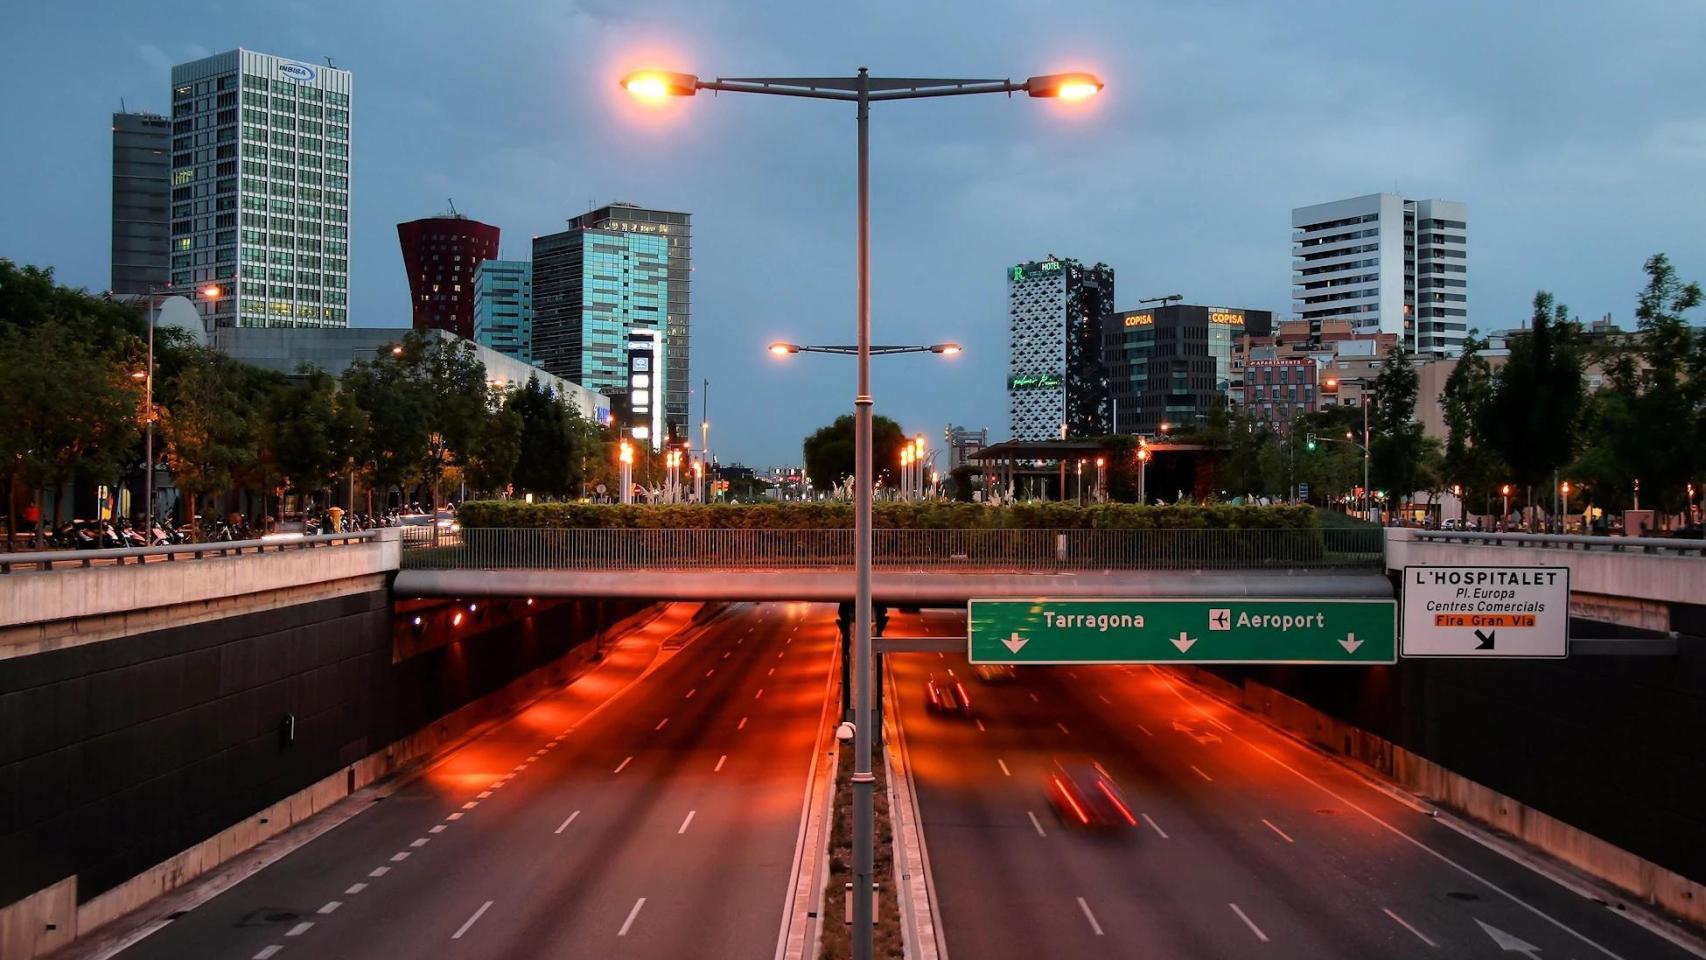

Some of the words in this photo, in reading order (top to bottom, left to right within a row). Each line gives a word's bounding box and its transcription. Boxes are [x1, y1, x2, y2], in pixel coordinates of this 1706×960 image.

[1042, 262, 1060, 271] HOTEL
[1125, 314, 1152, 326] COPISA
[1212, 313, 1244, 325] COPISA
[1416, 571, 1557, 585] L'HOSPITALET
[1456, 588, 1470, 599] Pl.
[1473, 588, 1515, 601] Europa
[1426, 601, 1474, 612] Centres
[1477, 601, 1545, 612] Comercials
[1044, 612, 1144, 631] Tarragona
[1236, 612, 1324, 631] Aeroport
[1436, 615, 1464, 626] Fira
[1471, 615, 1504, 626] Gran
[1512, 615, 1535, 626] Via
